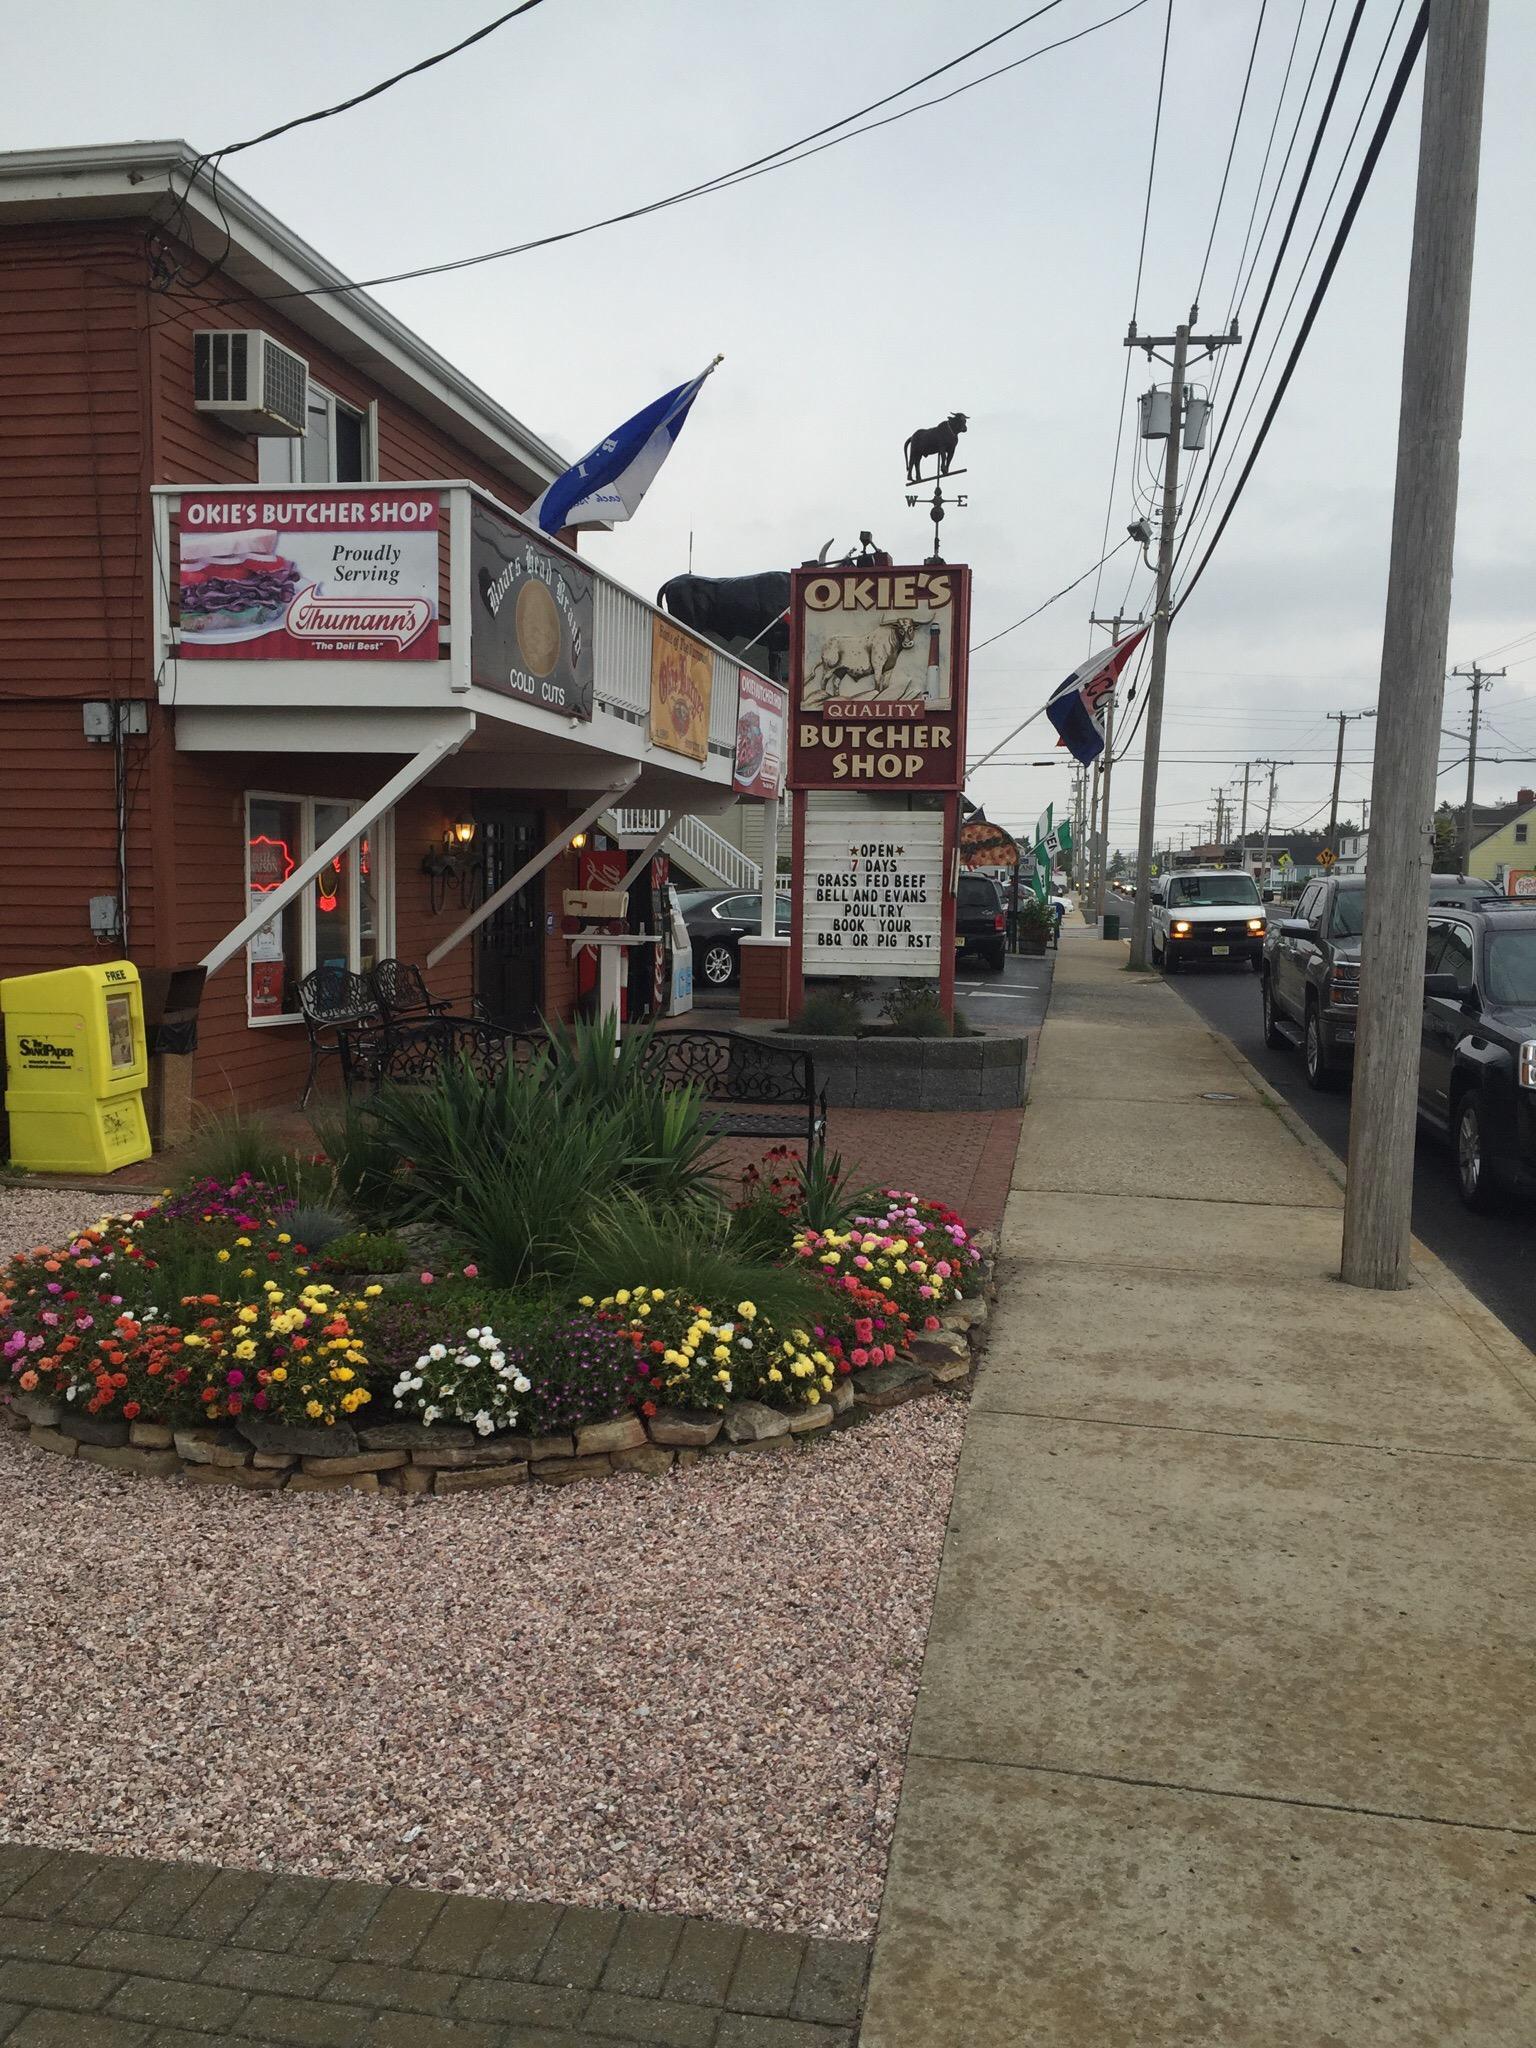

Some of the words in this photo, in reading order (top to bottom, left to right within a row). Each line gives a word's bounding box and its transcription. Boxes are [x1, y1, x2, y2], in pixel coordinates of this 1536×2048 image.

[905, 495, 918, 507] W
[957, 495, 968, 507] E
[187, 504, 257, 524] OKIE'S
[262, 503, 366, 524] BUTCHER
[370, 501, 433, 523] SHOP
[331, 545, 401, 564] Proudly
[333, 566, 400, 585] Serving
[804, 573, 951, 611] OKIE'S
[296, 605, 416, 631] Thumann's
[335, 641, 356, 651] Deli
[510, 669, 535, 695] COLD
[541, 683, 565, 706] CUTS
[827, 704, 919, 718] QUALITY
[800, 724, 952, 748] BUTCHER
[832, 752, 924, 779] SHOP
[860, 844, 894, 858] OPEN
[852, 860, 858, 872] 7
[865, 860, 898, 873] DAYS
[817, 873, 857, 887] GRASS
[865, 875, 889, 888] FED
[894, 875, 926, 888] BEEF
[816, 889, 848, 902] BELL
[853, 890, 878, 902] AND
[884, 890, 927, 903] EVANS
[844, 904, 903, 917] POULTRY
[833, 919, 865, 932] BOOK
[879, 920, 911, 933] YOUR
[817, 933, 841, 946] BBQ
[852, 934, 868, 947] OR
[877, 934, 897, 947] PIG
[907, 935, 932, 948] RST
[105, 970, 127, 981] FREE
